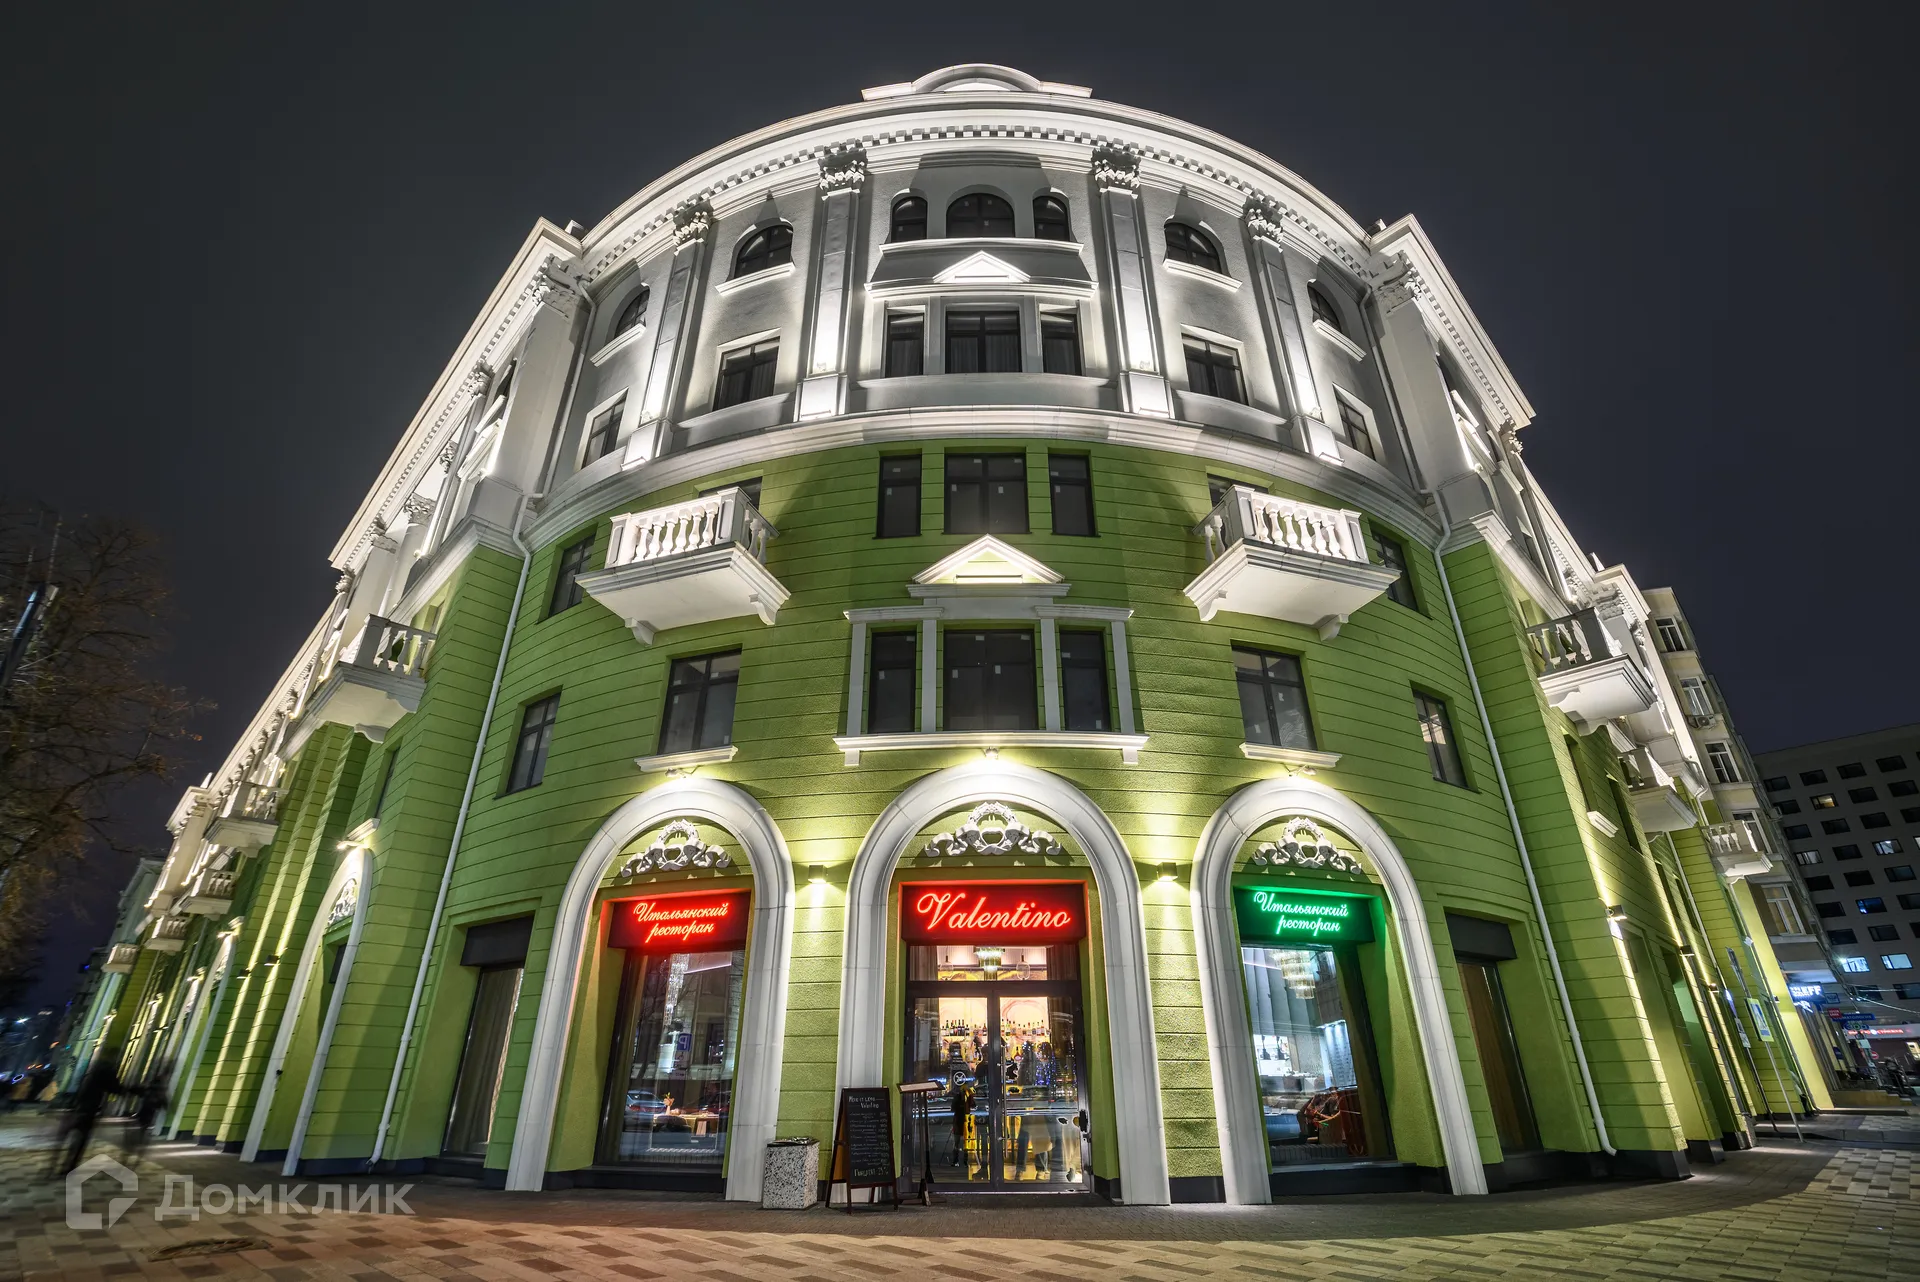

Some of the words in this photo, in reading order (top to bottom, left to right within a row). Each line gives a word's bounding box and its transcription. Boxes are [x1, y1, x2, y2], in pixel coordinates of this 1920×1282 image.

[633, 902, 729, 922] Итальянский
[917, 892, 1070, 930] Valentino
[1253, 891, 1349, 917] Итальянский
[645, 920, 714, 944] ресторан
[1275, 914, 1340, 937] ресторан
